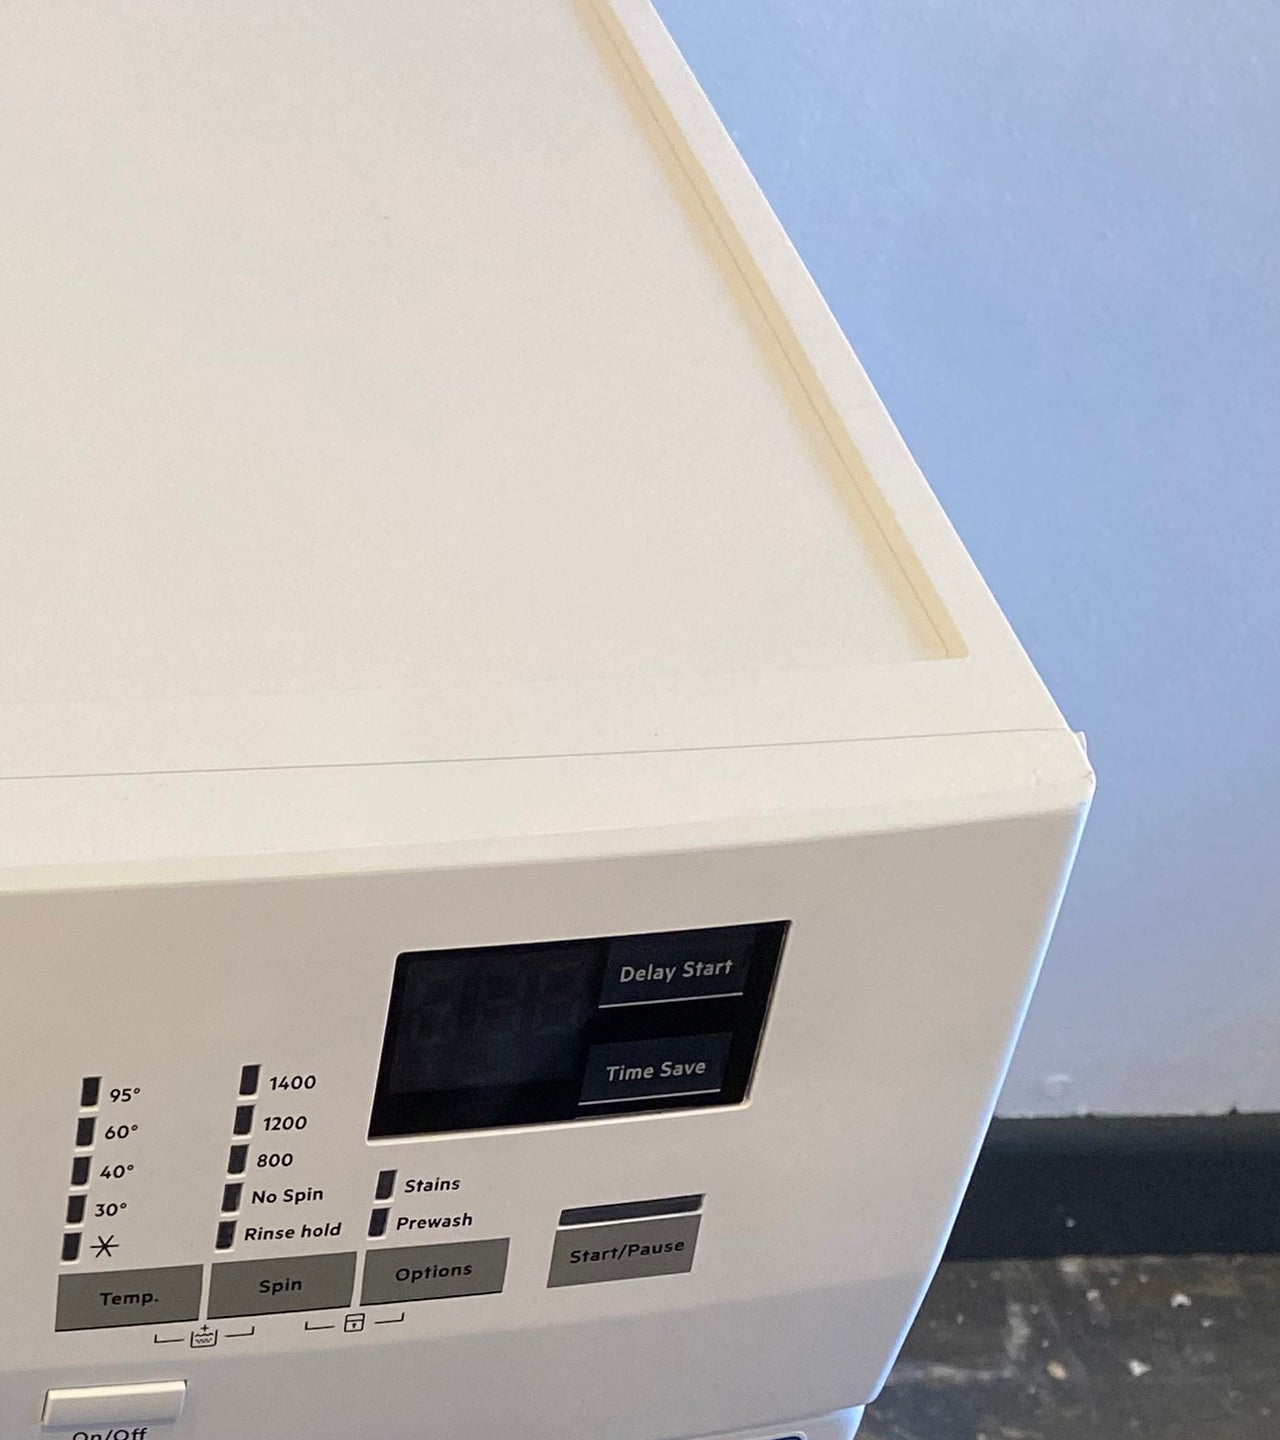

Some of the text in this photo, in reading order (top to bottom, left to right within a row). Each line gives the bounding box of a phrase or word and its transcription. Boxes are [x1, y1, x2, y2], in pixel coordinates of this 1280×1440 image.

[619, 959, 734, 983] Delay Start
[606, 1061, 706, 1082] Time Save
[269, 1075, 317, 1091] 1400
[109, 1087, 141, 1103] 95°
[104, 1124, 139, 1140] 60°
[263, 1115, 308, 1132] 1200
[256, 1152, 294, 1168] 800
[99, 1164, 135, 1180] 40°
[404, 1176, 461, 1194] Stains
[251, 1187, 324, 1206] No Spin
[94, 1202, 128, 1218] 30°
[396, 1212, 473, 1231] Prewash
[244, 1221, 342, 1241] Rinse hold
[569, 1241, 685, 1264] Start/Pause
[395, 1264, 473, 1284] Options
[258, 1277, 302, 1296] Spin
[99, 1291, 159, 1307] Temp.
